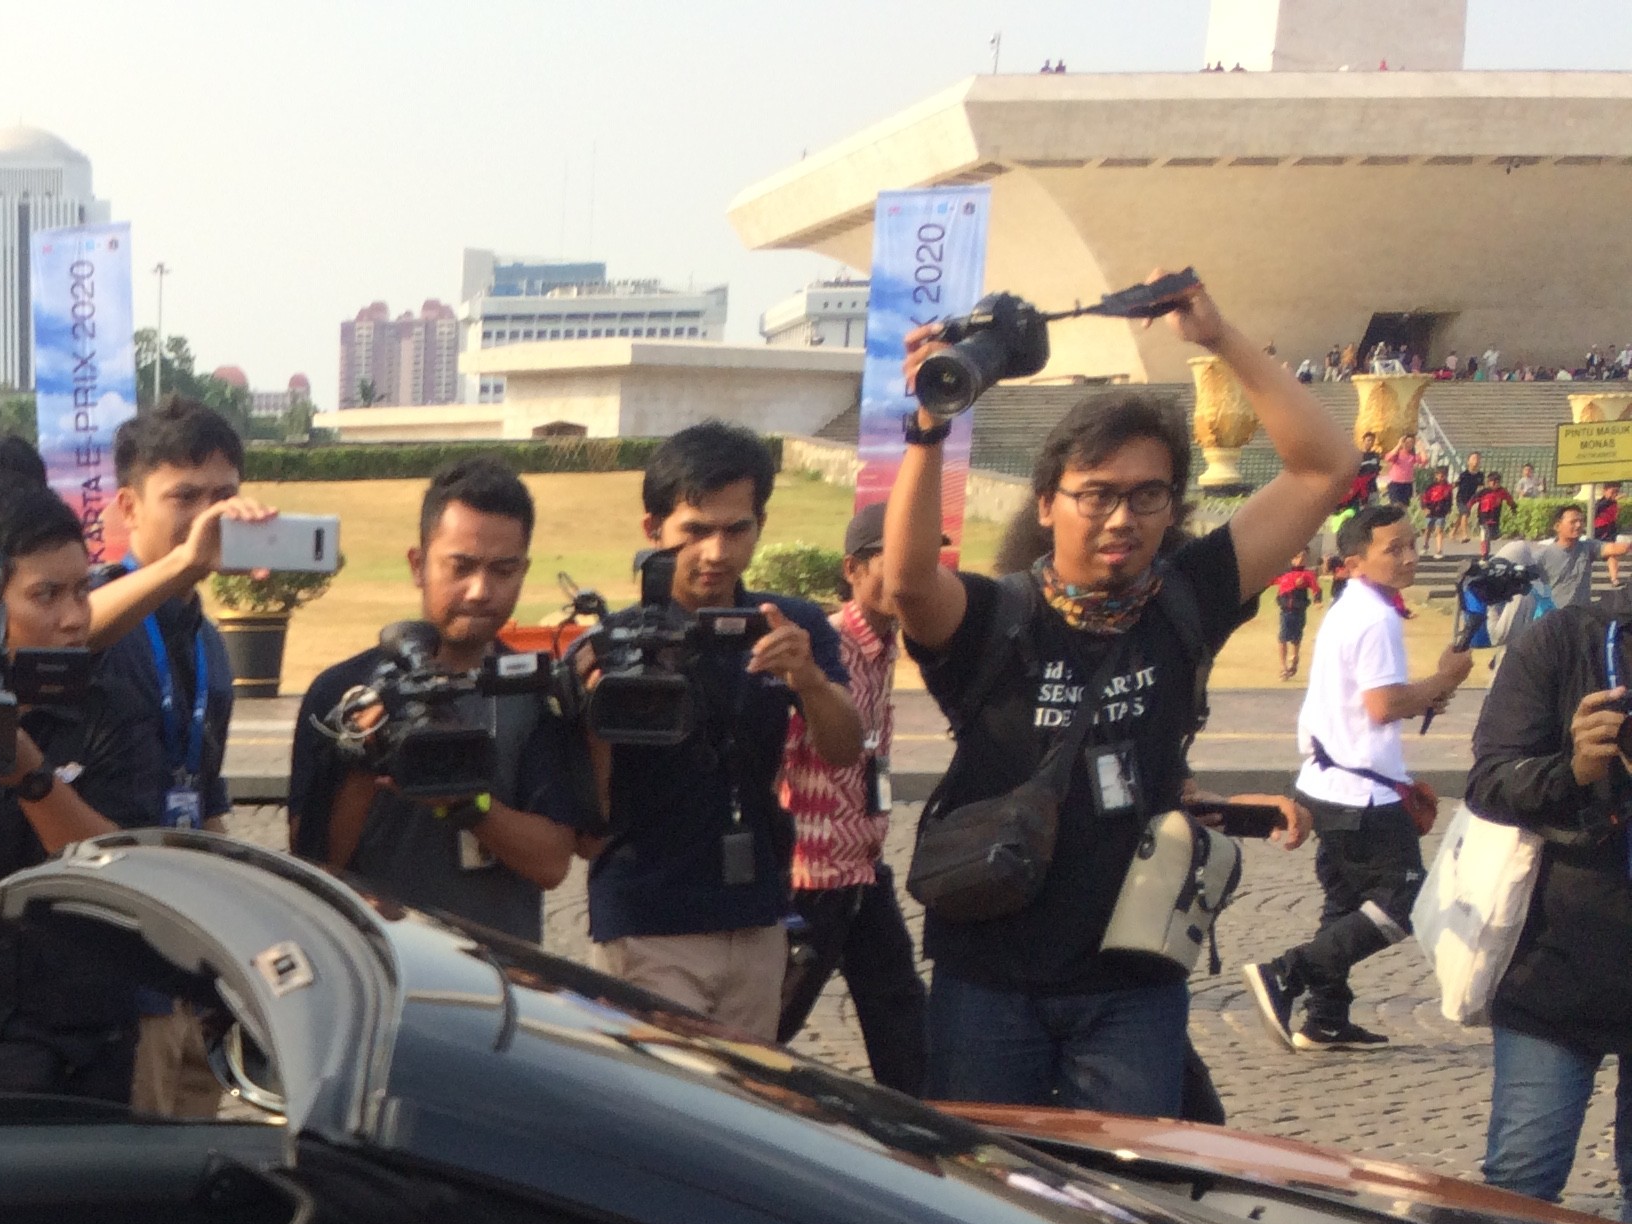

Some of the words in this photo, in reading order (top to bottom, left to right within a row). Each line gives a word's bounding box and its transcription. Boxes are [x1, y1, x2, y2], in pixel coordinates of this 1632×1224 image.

[69, 259, 97, 340] 2020
[912, 222, 946, 306] 2020
[72, 350, 102, 467] E-PRIX
[1564, 427, 1594, 438] PINTU
[1596, 425, 1631, 436] MASUK
[1579, 438, 1616, 450] MONAS
[81, 473, 107, 565] KARTA
